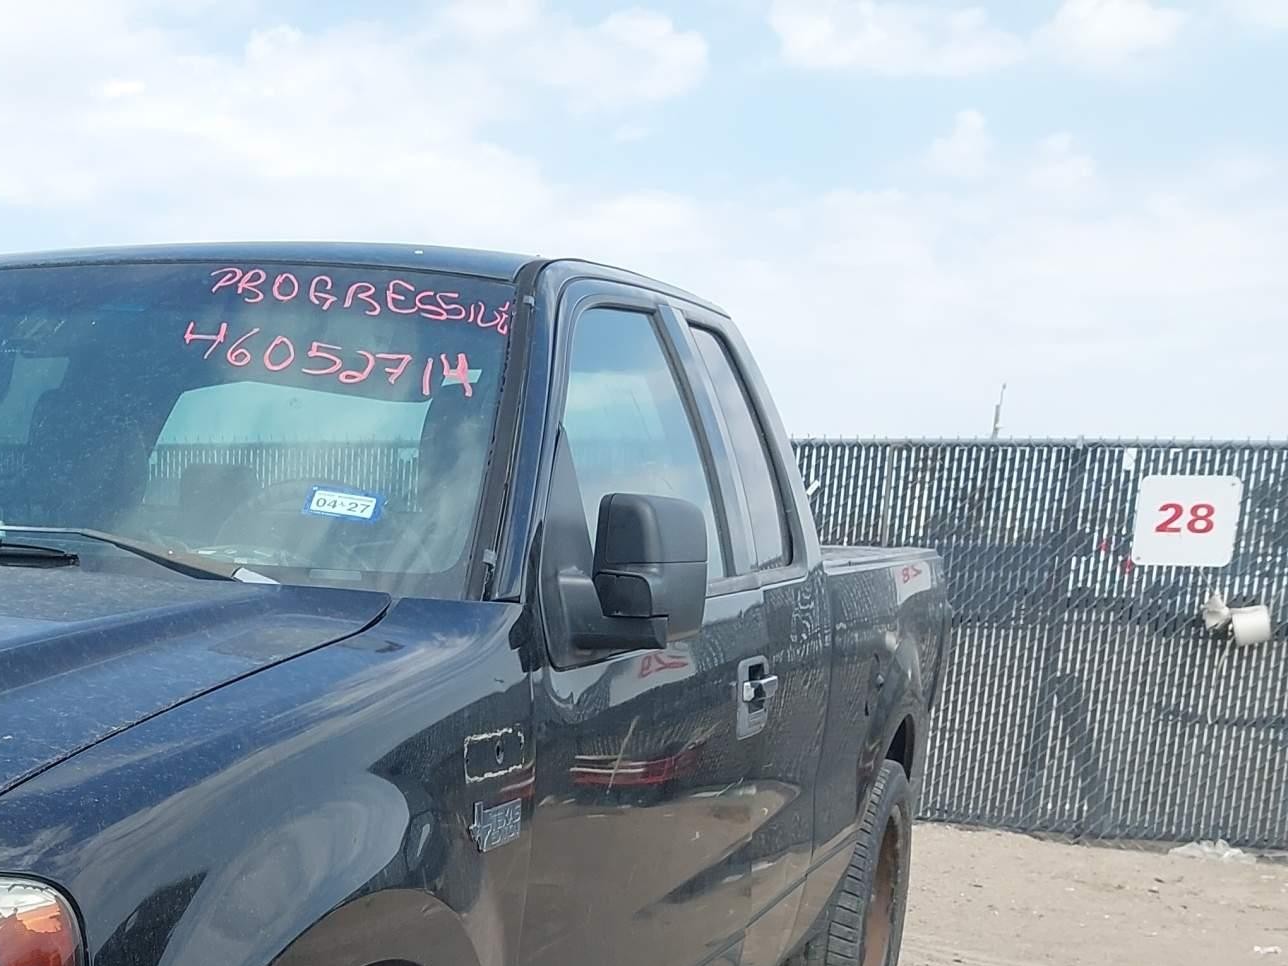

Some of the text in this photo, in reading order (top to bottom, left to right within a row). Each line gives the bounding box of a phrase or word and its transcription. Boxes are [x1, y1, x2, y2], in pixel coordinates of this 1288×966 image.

[183, 320, 474, 398] 46052714
[316, 497, 338, 509] 04
[347, 502, 371, 514] 27
[1155, 503, 1215, 534] 28
